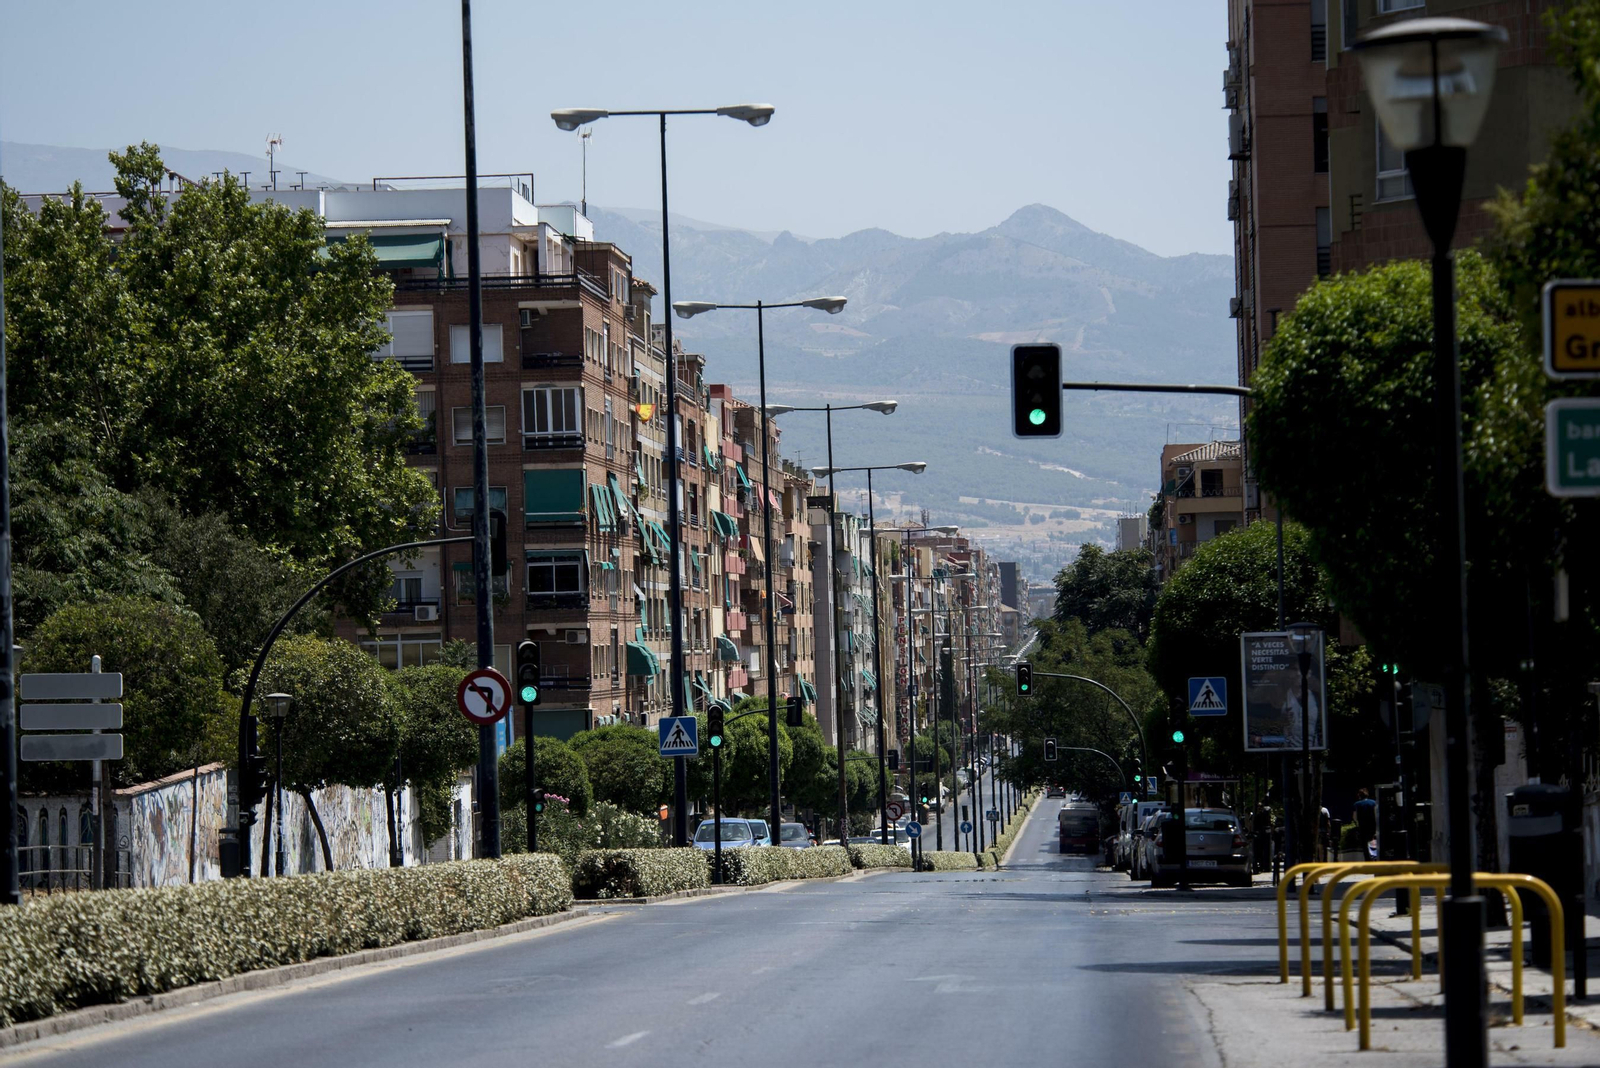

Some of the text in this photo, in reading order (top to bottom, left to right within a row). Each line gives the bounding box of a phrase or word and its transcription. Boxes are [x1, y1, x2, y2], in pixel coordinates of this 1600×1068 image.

[1566, 334, 1600, 358] Gr
[1567, 450, 1600, 478] La
[899, 617, 907, 685] PENSION
